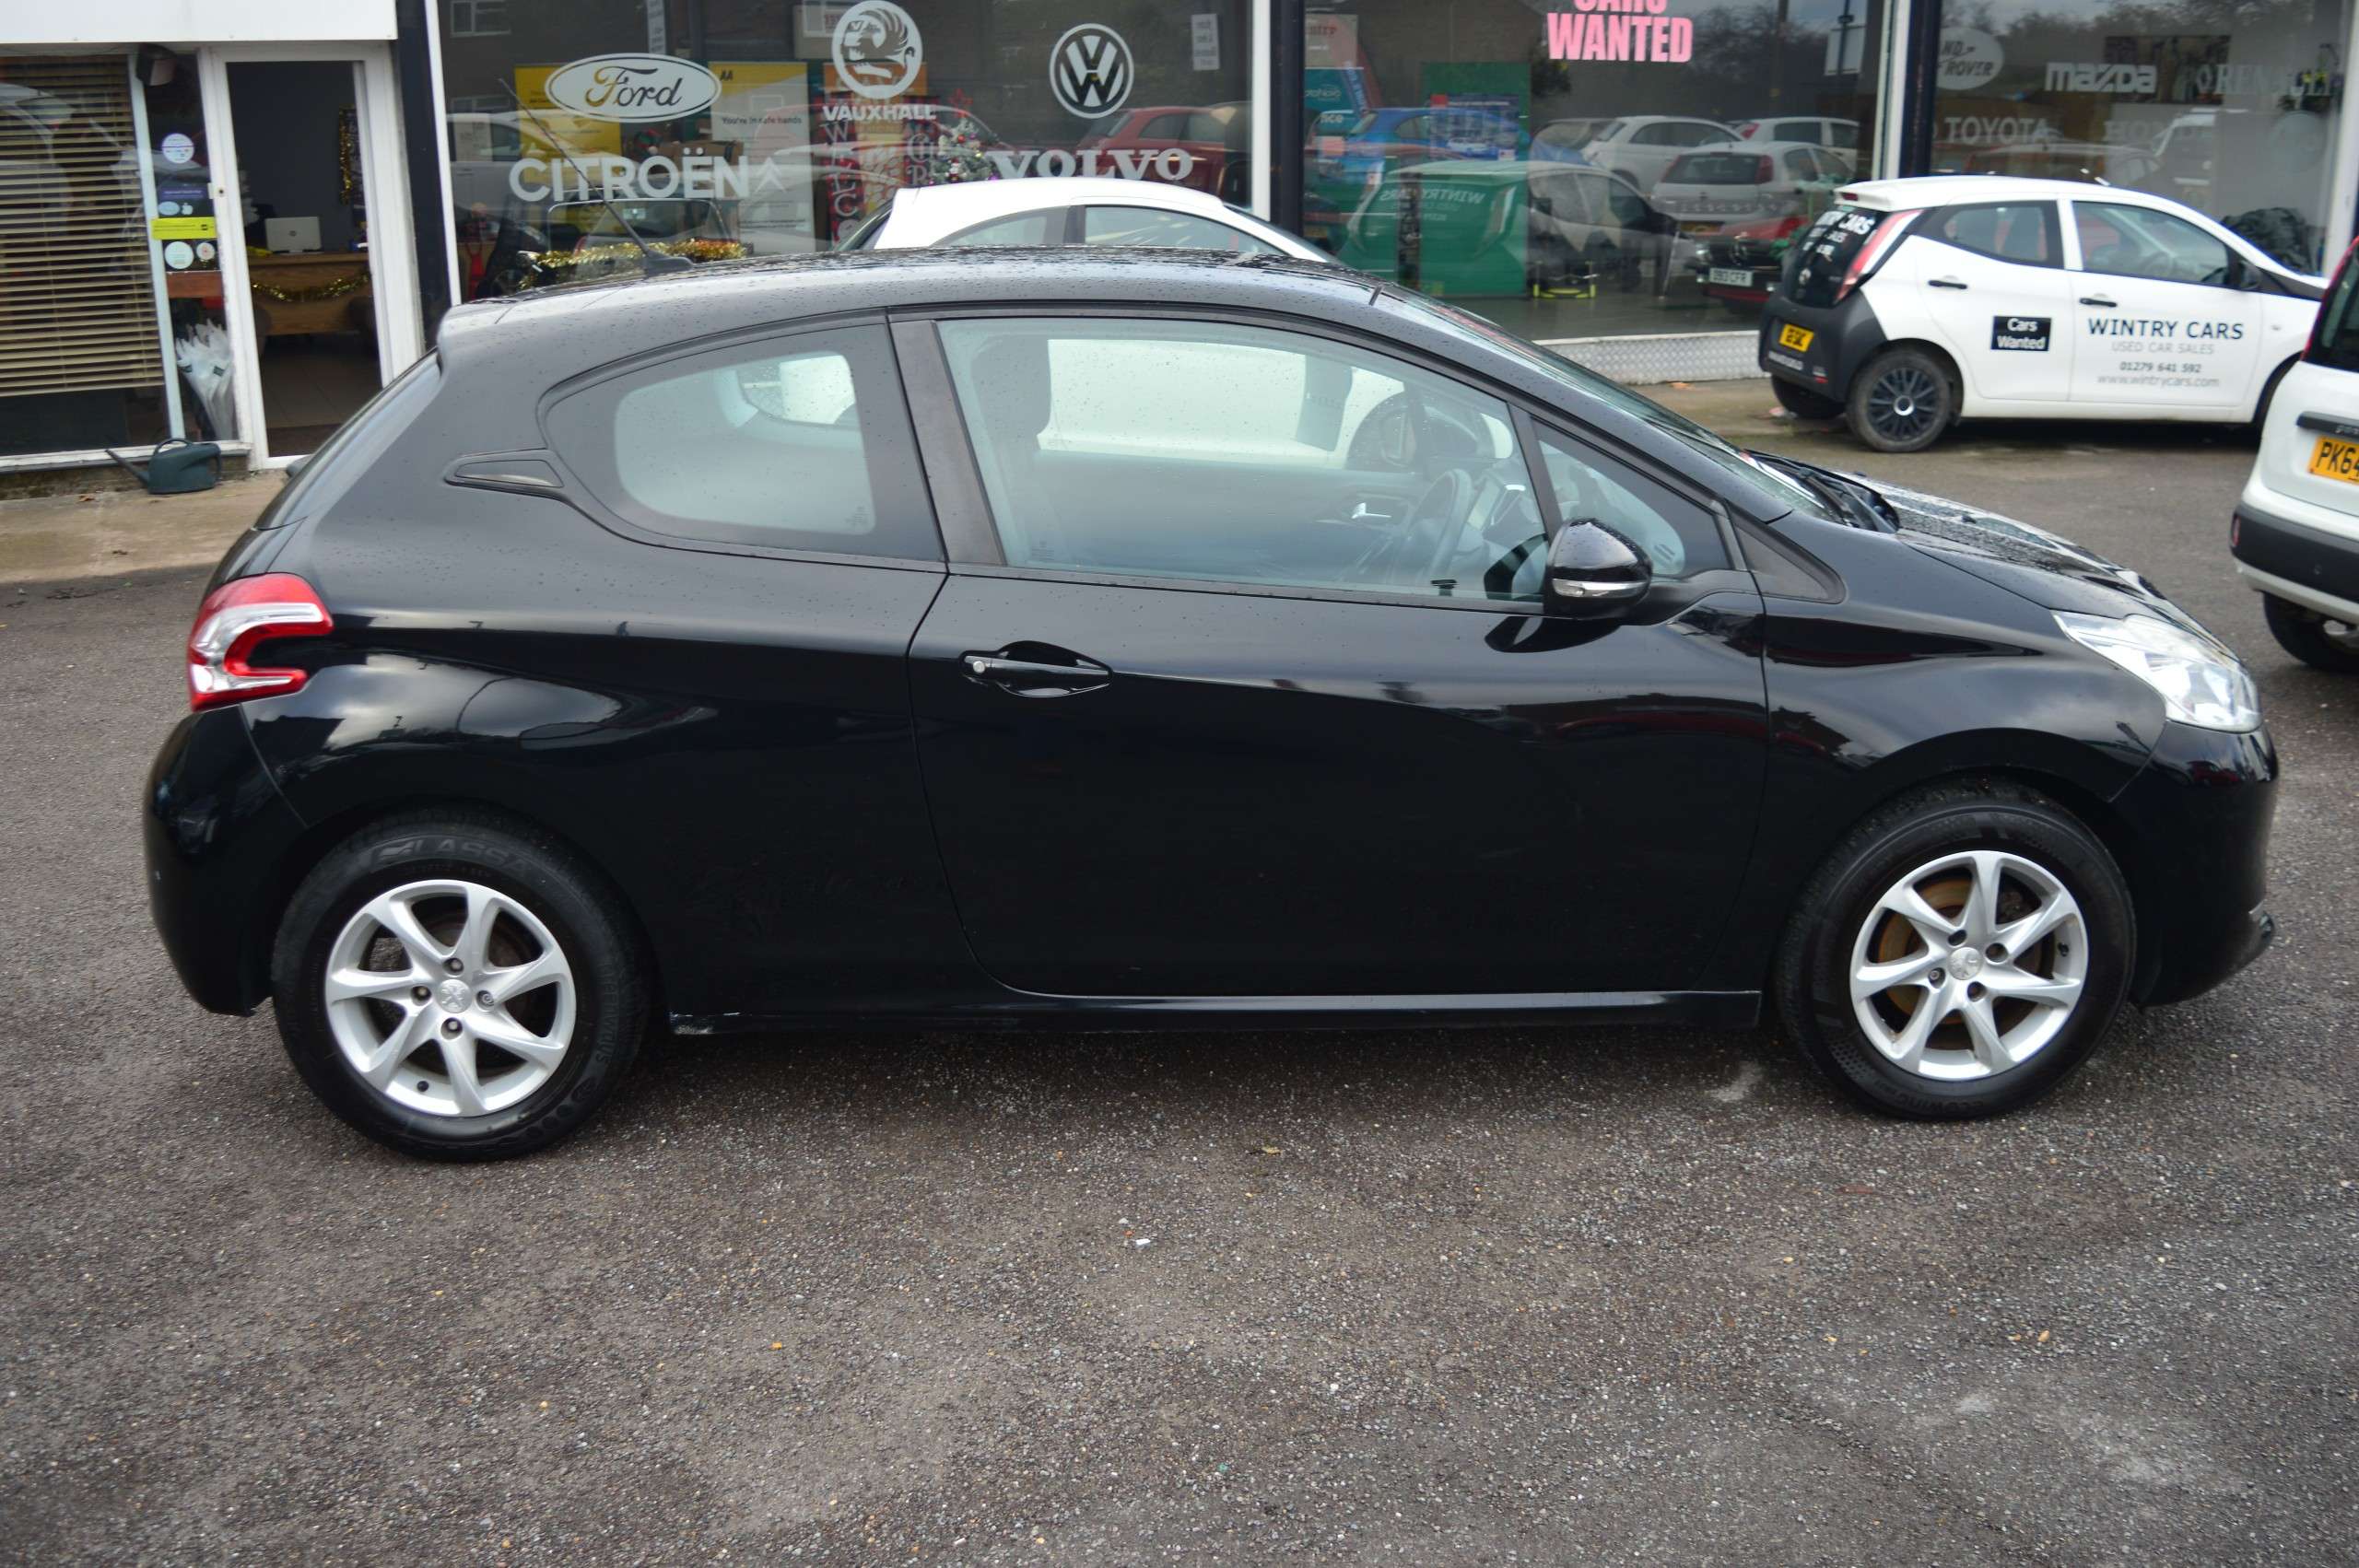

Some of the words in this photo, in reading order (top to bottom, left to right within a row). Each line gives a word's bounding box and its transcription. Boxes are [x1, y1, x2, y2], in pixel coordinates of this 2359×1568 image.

[1547, 13, 1694, 63] WANTED
[1944, 61, 1994, 76] ROVER
[585, 65, 684, 108] Ford
[823, 104, 937, 121] VAUXHALL
[1944, 116, 2049, 145] TOYOTA
[509, 147, 750, 203] CITROËN
[984, 148, 1194, 181] VOLVO
[2007, 317, 2038, 333] Cars
[2088, 318, 2178, 338] WINTRY
[2187, 322, 2245, 340] CARS
[1997, 334, 2047, 350] Wanted
[2112, 341, 2144, 353] USED
[2148, 342, 2174, 354] CAR
[2177, 343, 2215, 356] SALES
